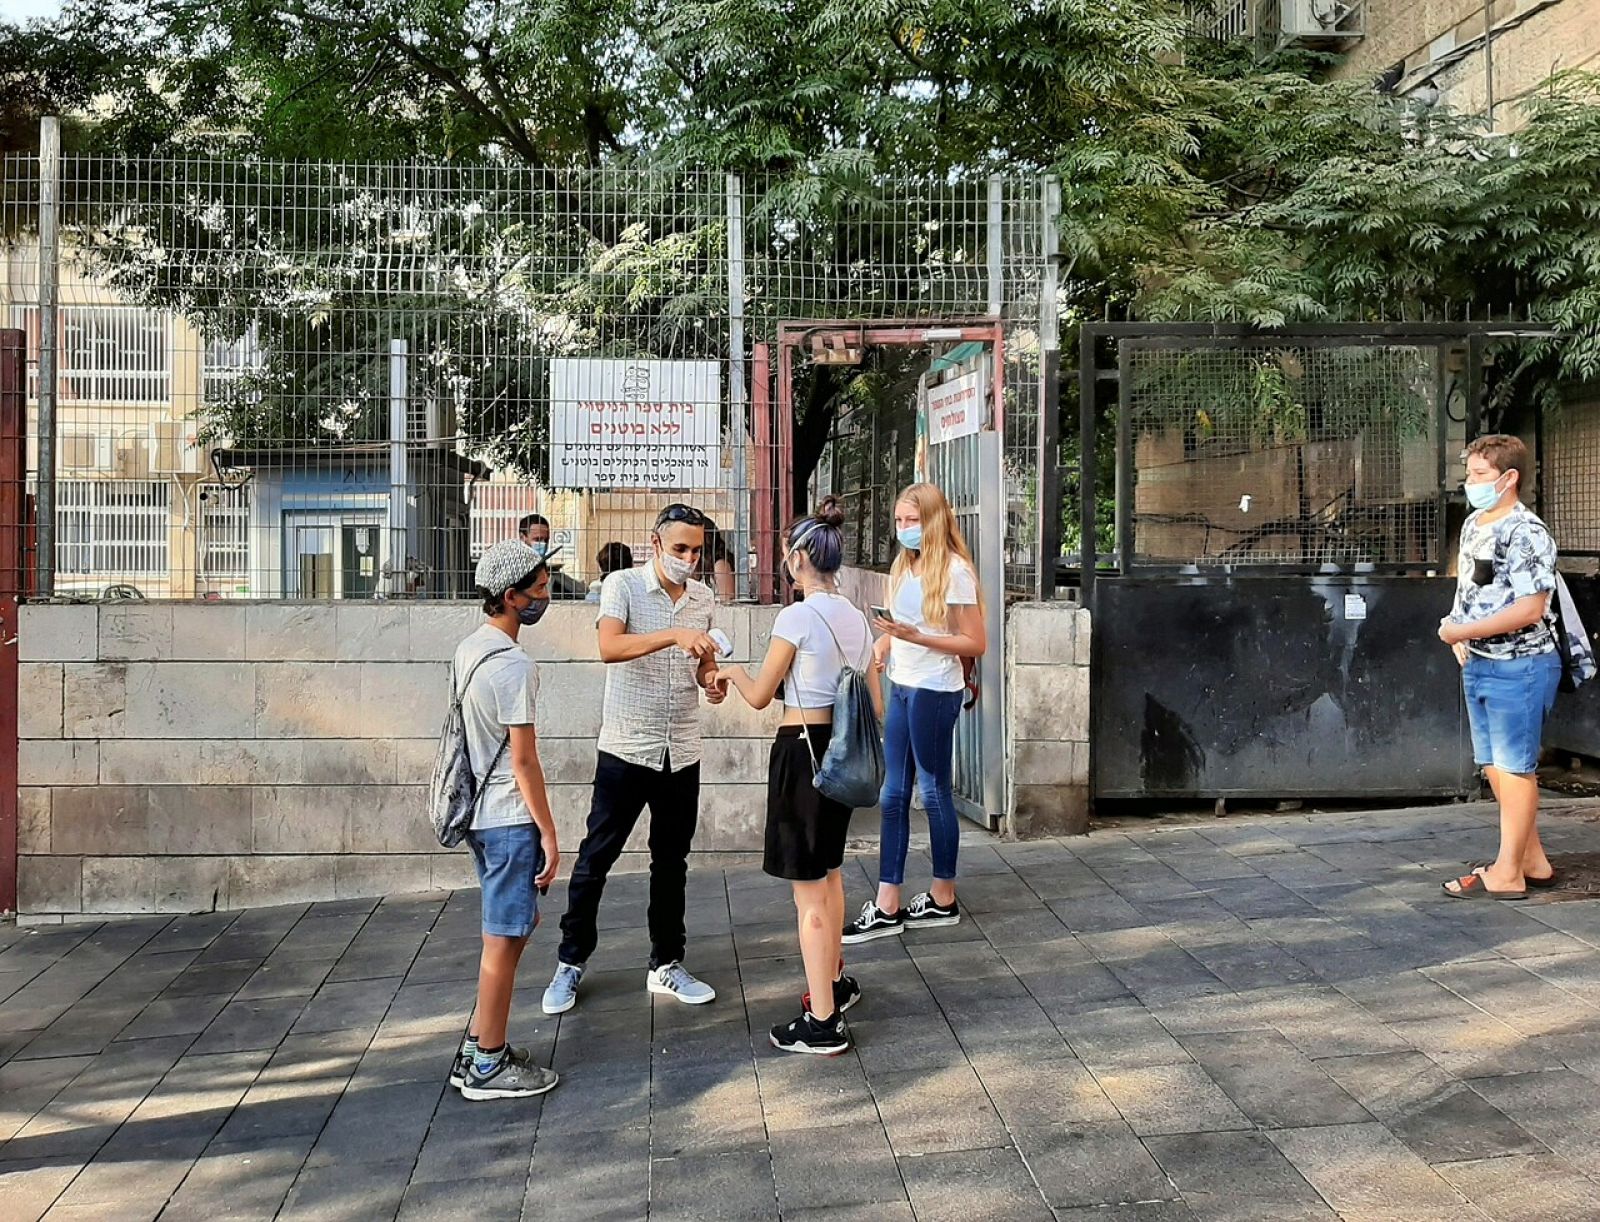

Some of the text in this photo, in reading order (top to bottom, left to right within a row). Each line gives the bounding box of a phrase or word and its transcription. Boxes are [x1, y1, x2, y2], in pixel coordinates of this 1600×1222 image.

[636, 402, 663, 413] ספר
[669, 402, 694, 414] בית
[591, 421, 680, 435] ללא בוטנים
[565, 443, 706, 452] אסורה הכניסה עם בוטנים
[603, 456, 647, 466] הכוללים
[651, 457, 694, 467] מאכלים
[697, 458, 709, 467] או
[595, 472, 676, 482] לשטח בית ספר
